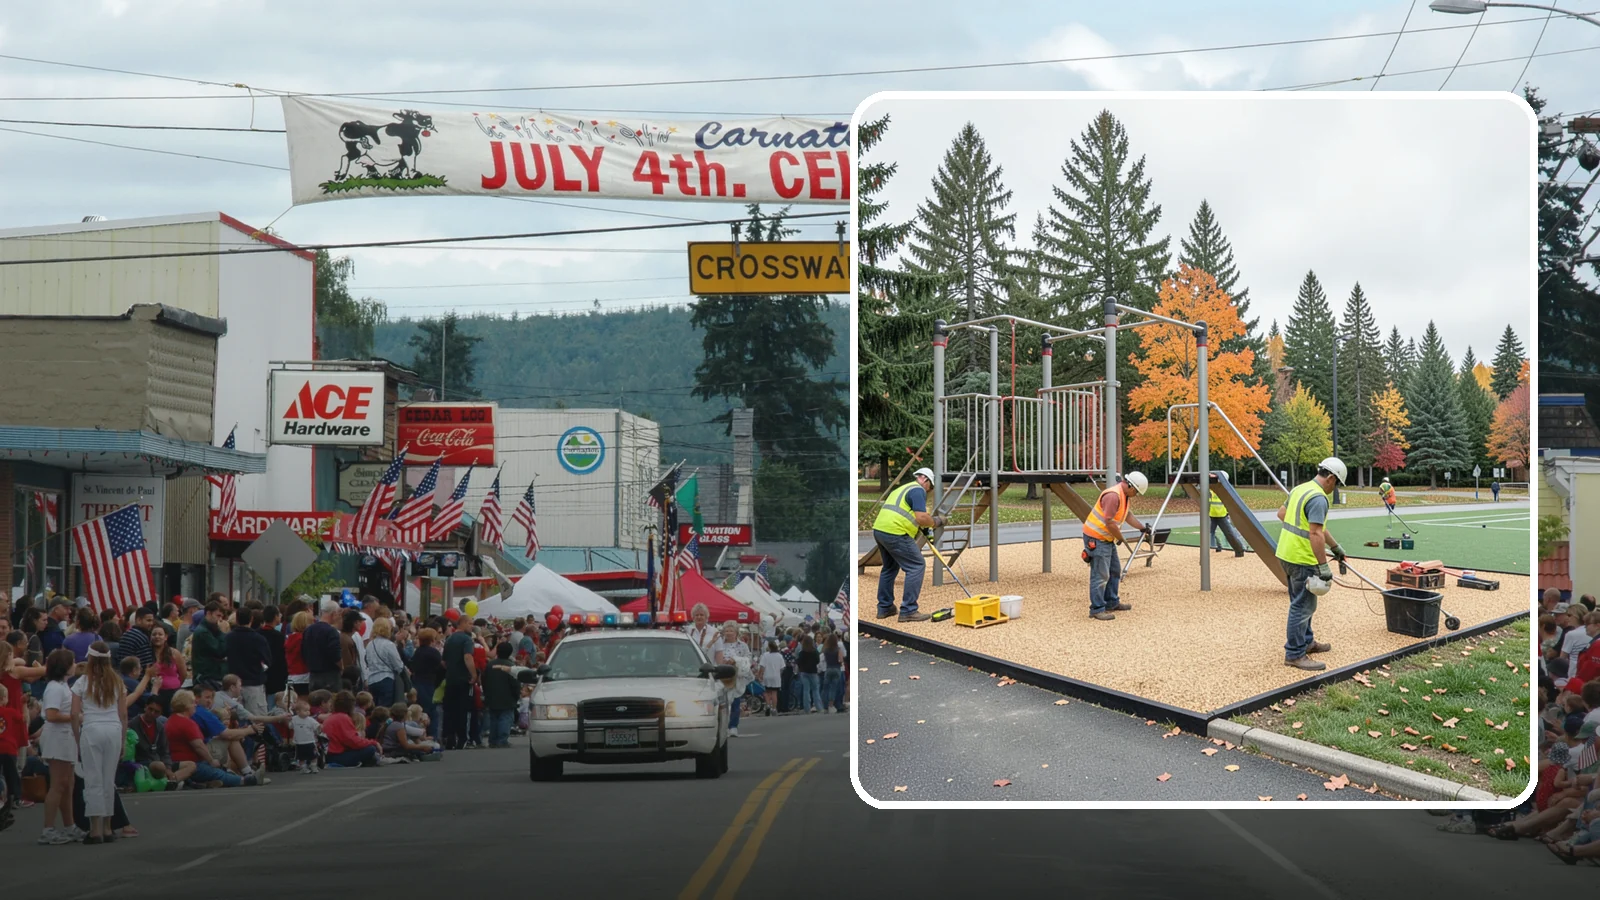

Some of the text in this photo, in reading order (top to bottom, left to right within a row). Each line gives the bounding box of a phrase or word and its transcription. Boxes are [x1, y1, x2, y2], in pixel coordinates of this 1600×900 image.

[481, 140, 605, 193] JULY
[632, 149, 746, 198] 4th.
[697, 254, 850, 280] CROSSWA
[283, 380, 373, 420] ACE
[406, 409, 452, 422] CEDAR
[283, 421, 370, 436] Hardware
[416, 428, 477, 447] Coca-Cola
[95, 485, 124, 495] Vincent
[126, 486, 136, 495] de
[137, 486, 155, 495] Paul
[688, 526, 741, 535] CRNATION
[699, 535, 730, 543] GLASS
